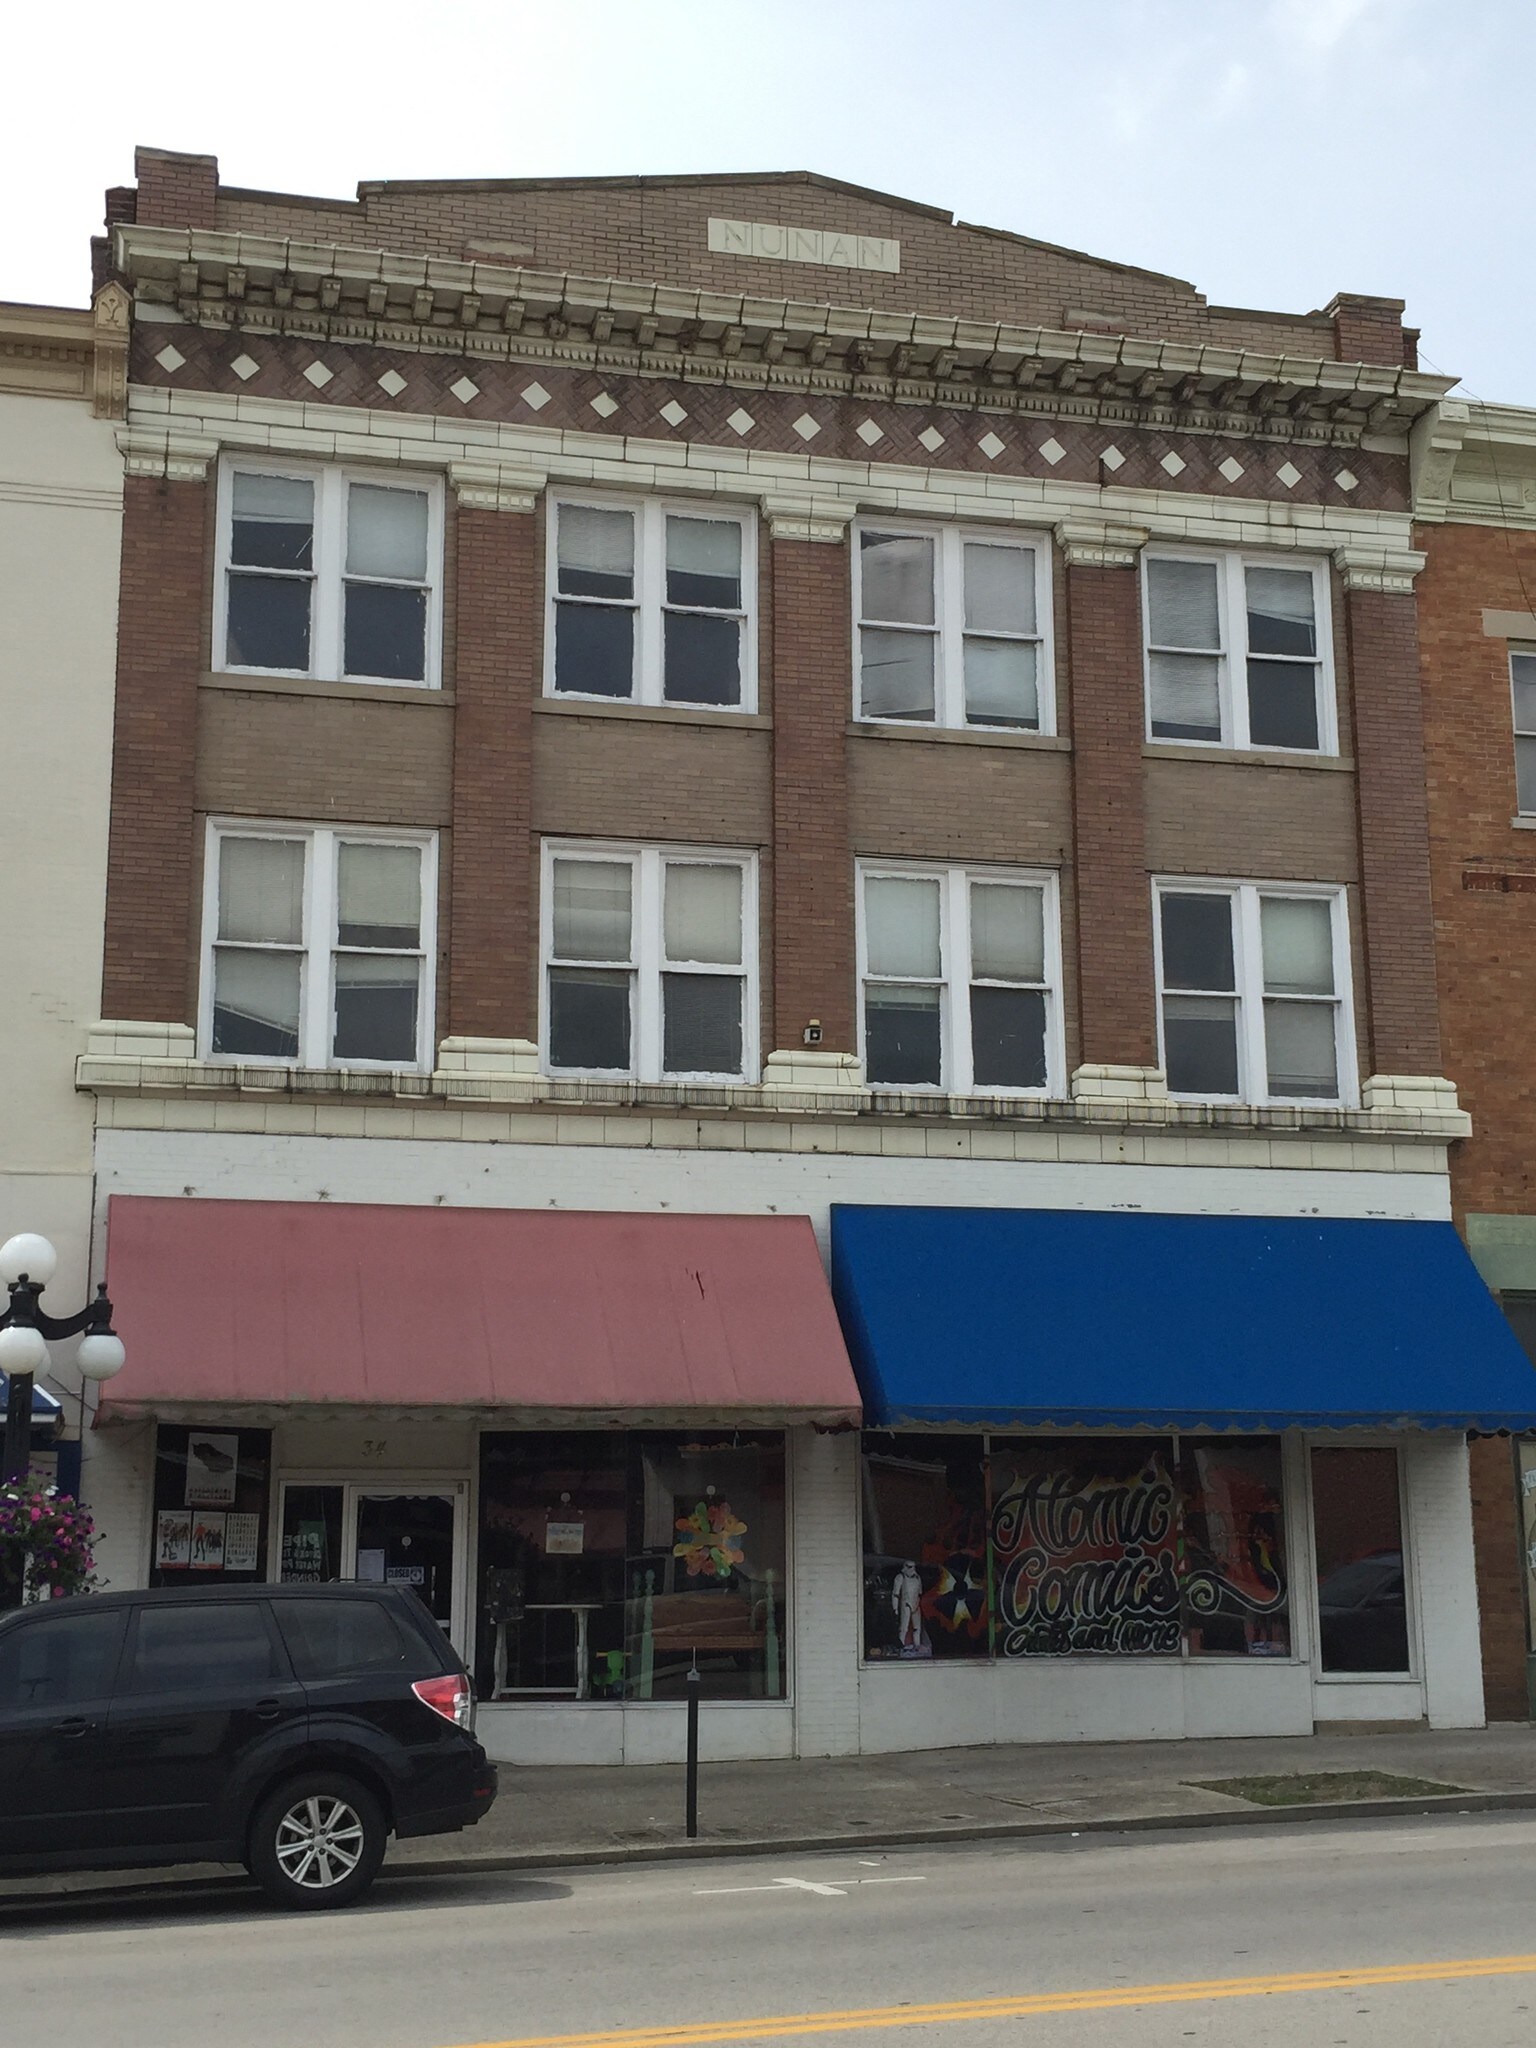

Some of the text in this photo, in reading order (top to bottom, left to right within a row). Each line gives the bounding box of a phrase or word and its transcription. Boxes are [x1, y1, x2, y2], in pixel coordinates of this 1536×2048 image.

[723, 221, 886, 267] NUNAN
[992, 1470, 1171, 1555] Atomic
[388, 1568, 410, 1579] CLOSED
[1002, 1546, 1180, 1627] Comics
[1072, 1617, 1120, 1652] and
